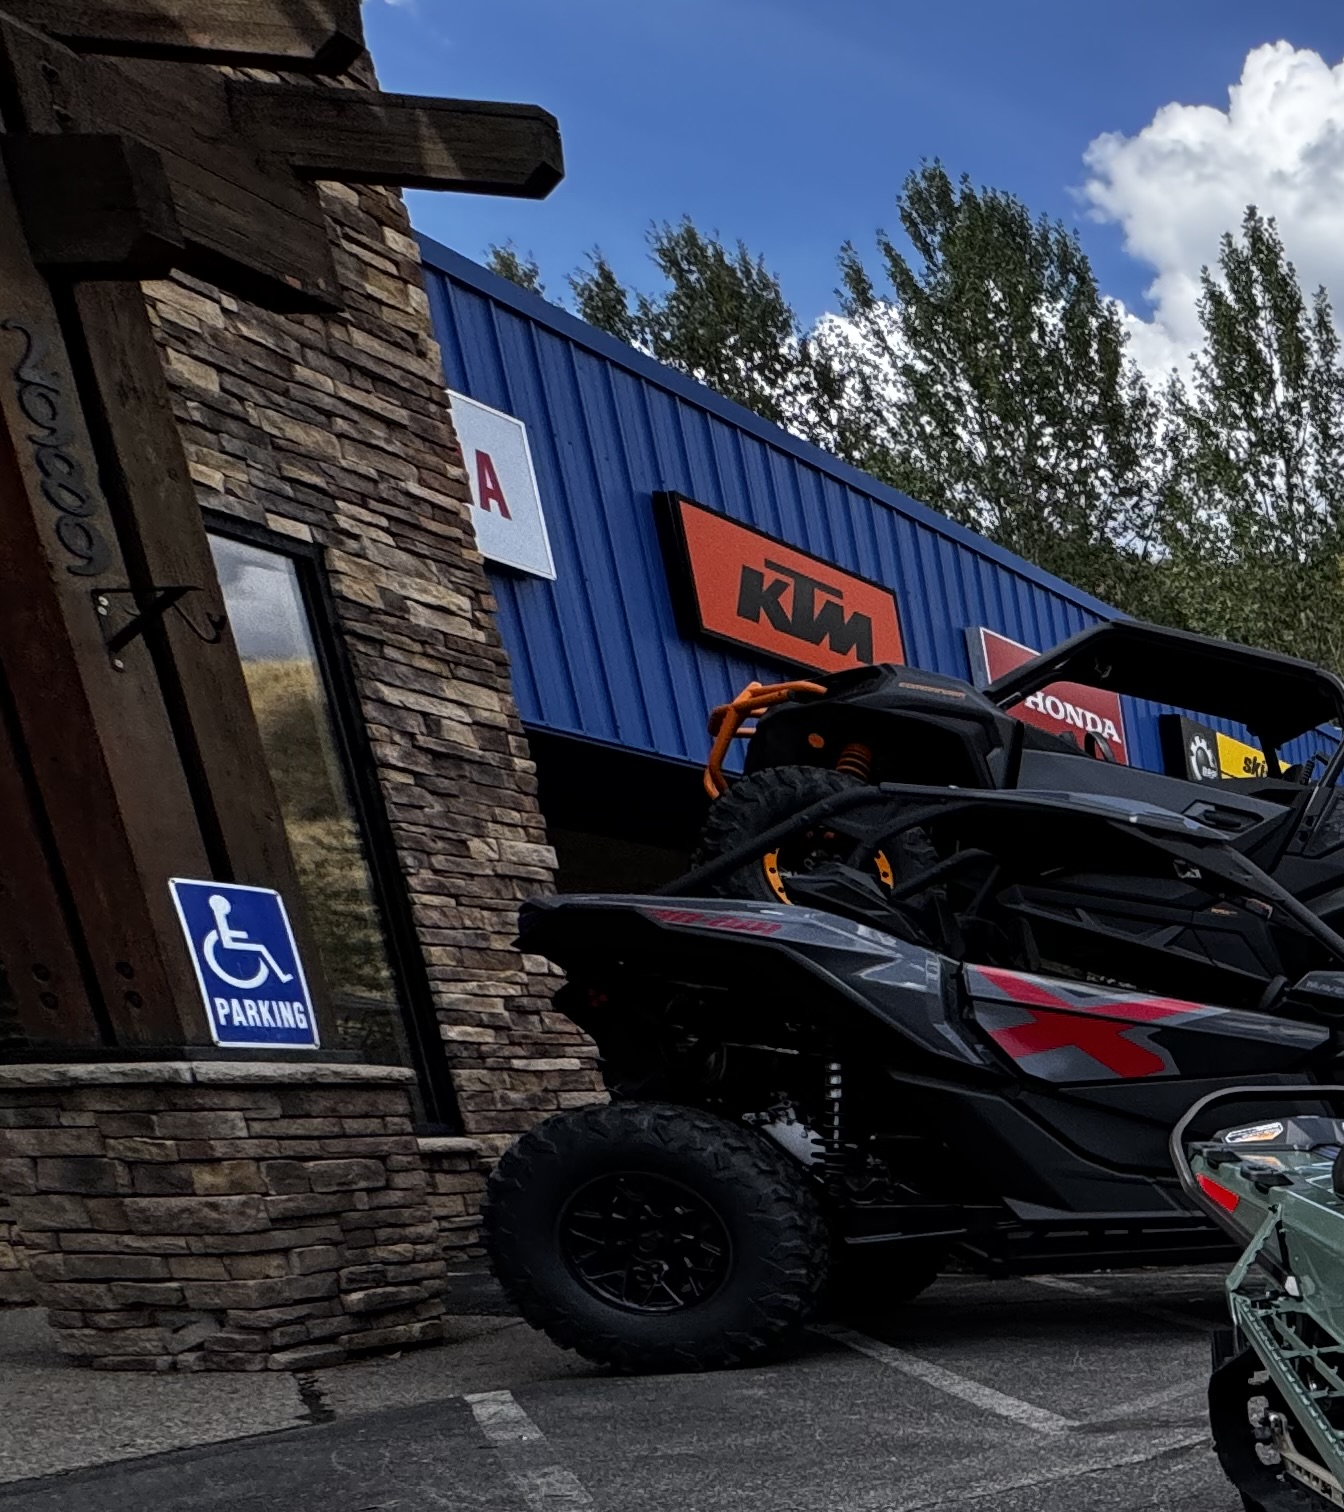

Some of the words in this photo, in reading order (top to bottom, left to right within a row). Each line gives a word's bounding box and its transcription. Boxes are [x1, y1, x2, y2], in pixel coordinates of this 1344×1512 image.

[737, 558, 874, 664] KTM
[1024, 691, 1122, 744] HONDA
[213, 997, 308, 1029] PARKING
